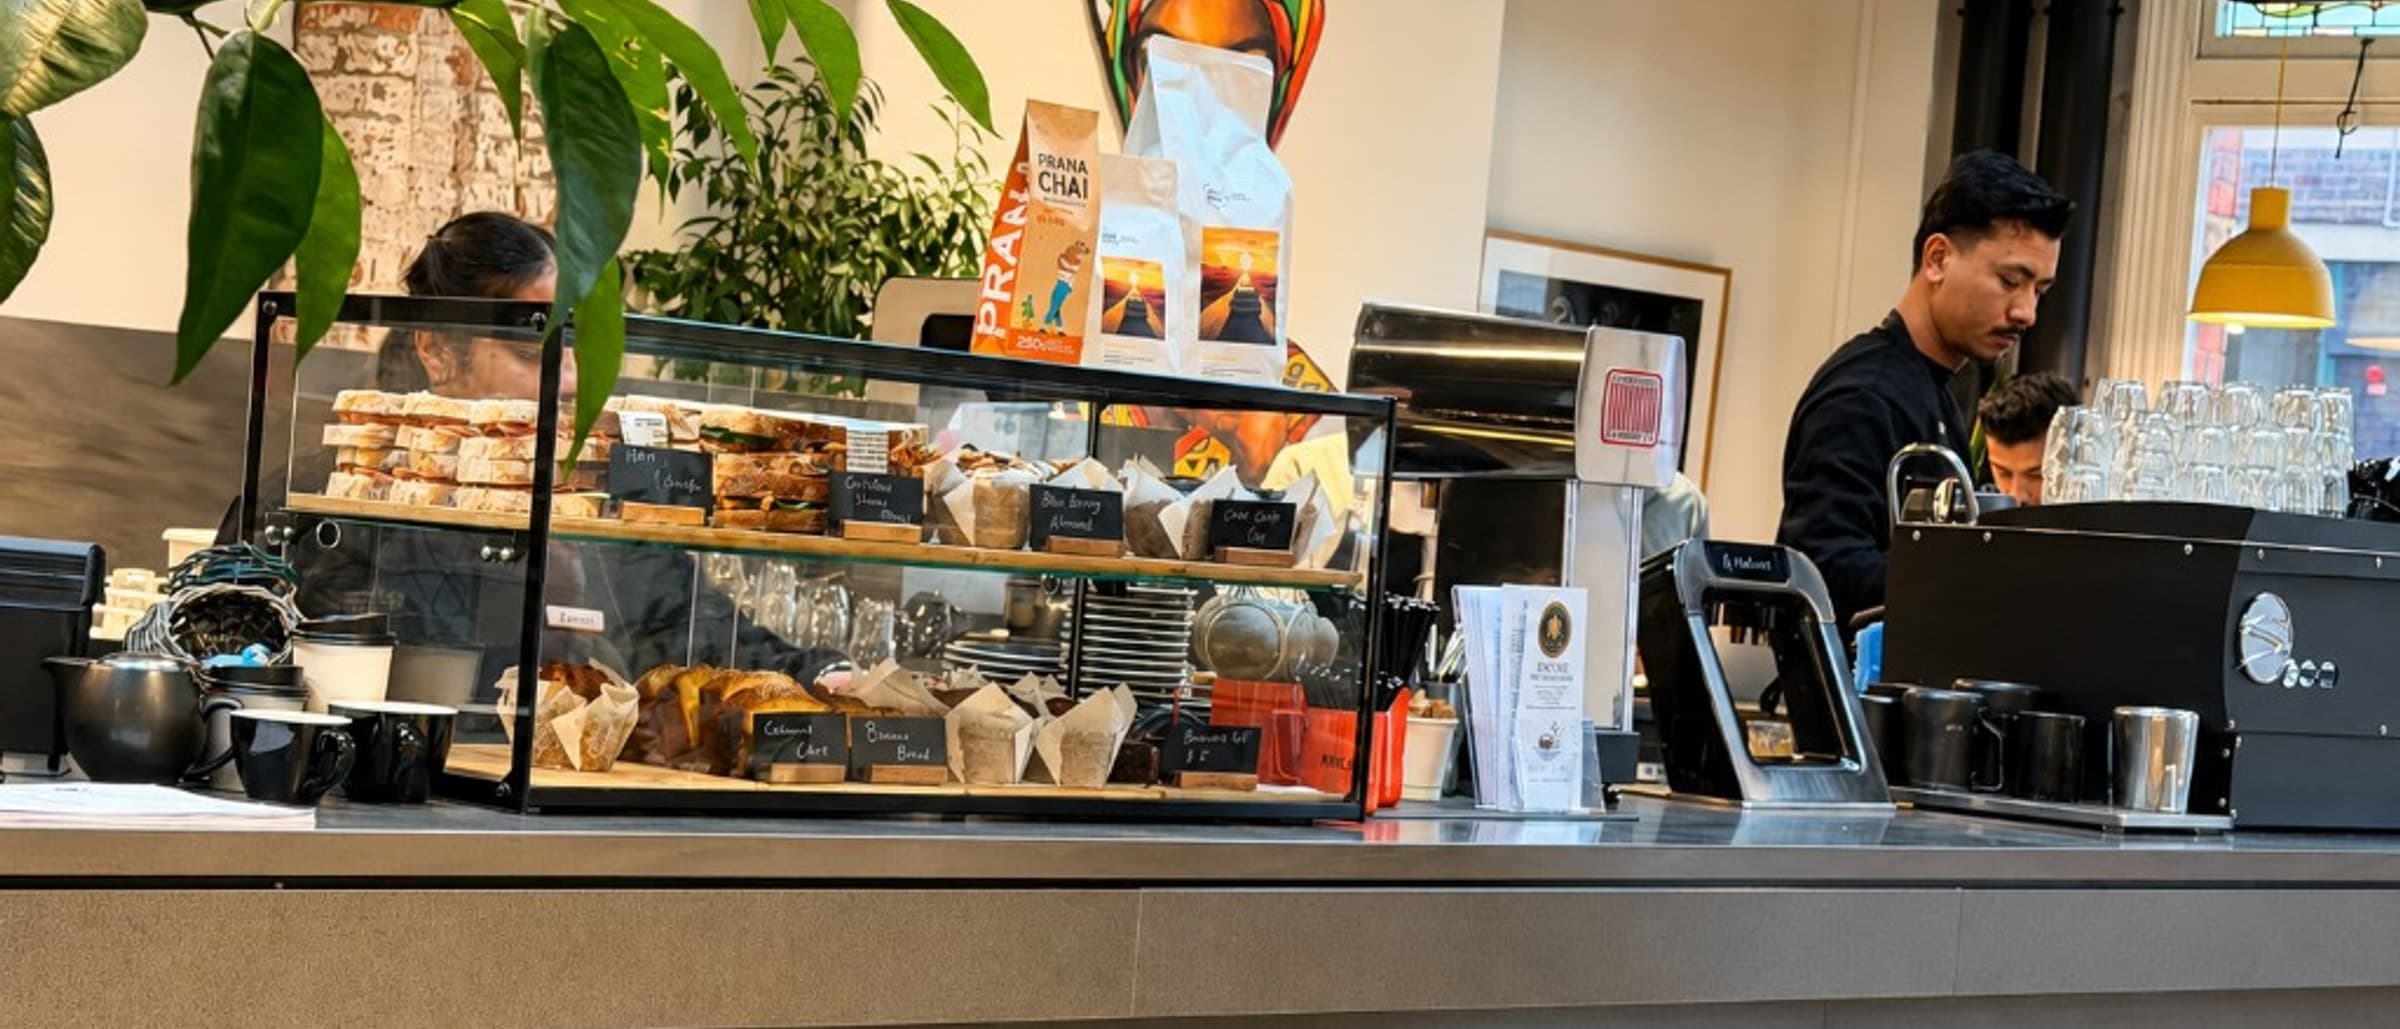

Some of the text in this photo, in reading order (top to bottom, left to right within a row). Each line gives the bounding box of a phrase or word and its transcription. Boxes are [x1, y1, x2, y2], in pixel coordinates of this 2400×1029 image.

[1037, 153, 1089, 175] PRANA
[1037, 170, 1089, 200] CHAI
[896, 743, 931, 762] Bread
